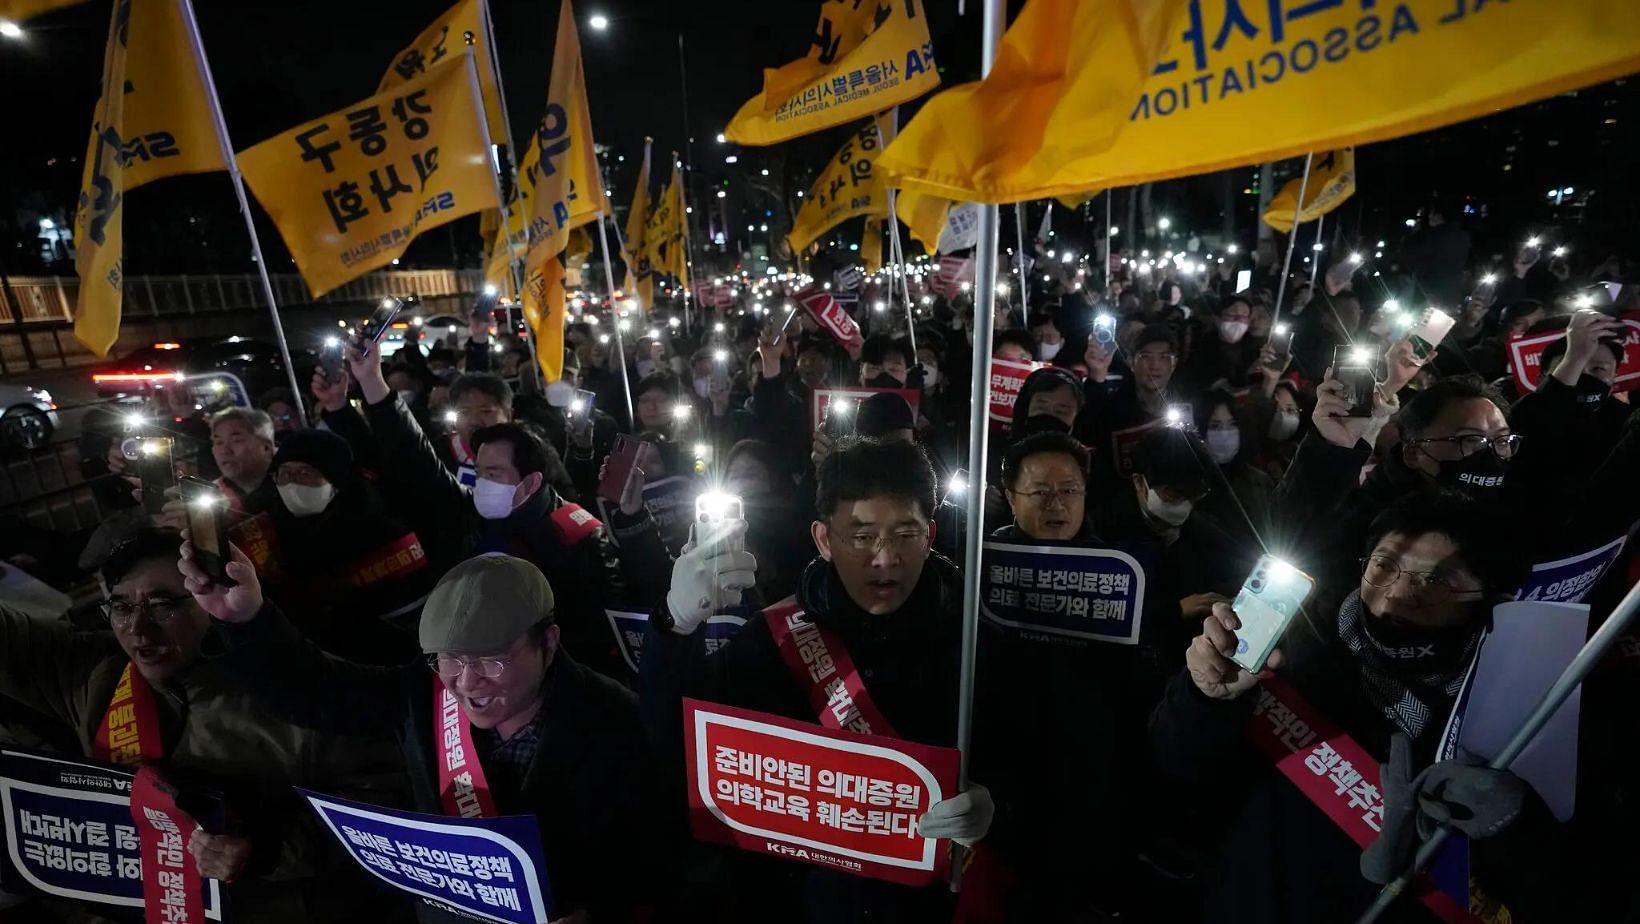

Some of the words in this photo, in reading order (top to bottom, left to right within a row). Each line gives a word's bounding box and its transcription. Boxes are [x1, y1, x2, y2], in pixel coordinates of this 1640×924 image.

[990, 565, 1034, 588] 올바른
[1037, 568, 1130, 597] 보건의료정책
[989, 587, 1021, 608] 의료
[1024, 592, 1089, 619] 전문가와
[1091, 597, 1128, 622] 함께
[454, 771, 486, 817] 확대
[715, 745, 812, 793] 준비안된
[816, 769, 921, 809] 의대증원
[19, 808, 110, 848] 결사반대
[716, 779, 811, 822] 의학교육
[815, 800, 920, 839] 훼손된다
[25, 839, 112, 877] 합의없는
[114, 823, 142, 850] 원
[143, 806, 184, 868] 일방적인
[342, 825, 397, 857] 올바른
[394, 840, 515, 883] 보건의료정책
[766, 841, 811, 859] KMA
[116, 854, 144, 881] 와
[358, 849, 402, 875] 의료
[396, 861, 477, 900] 전문가와
[473, 883, 523, 912] 함께
[159, 871, 190, 924] 정책추
